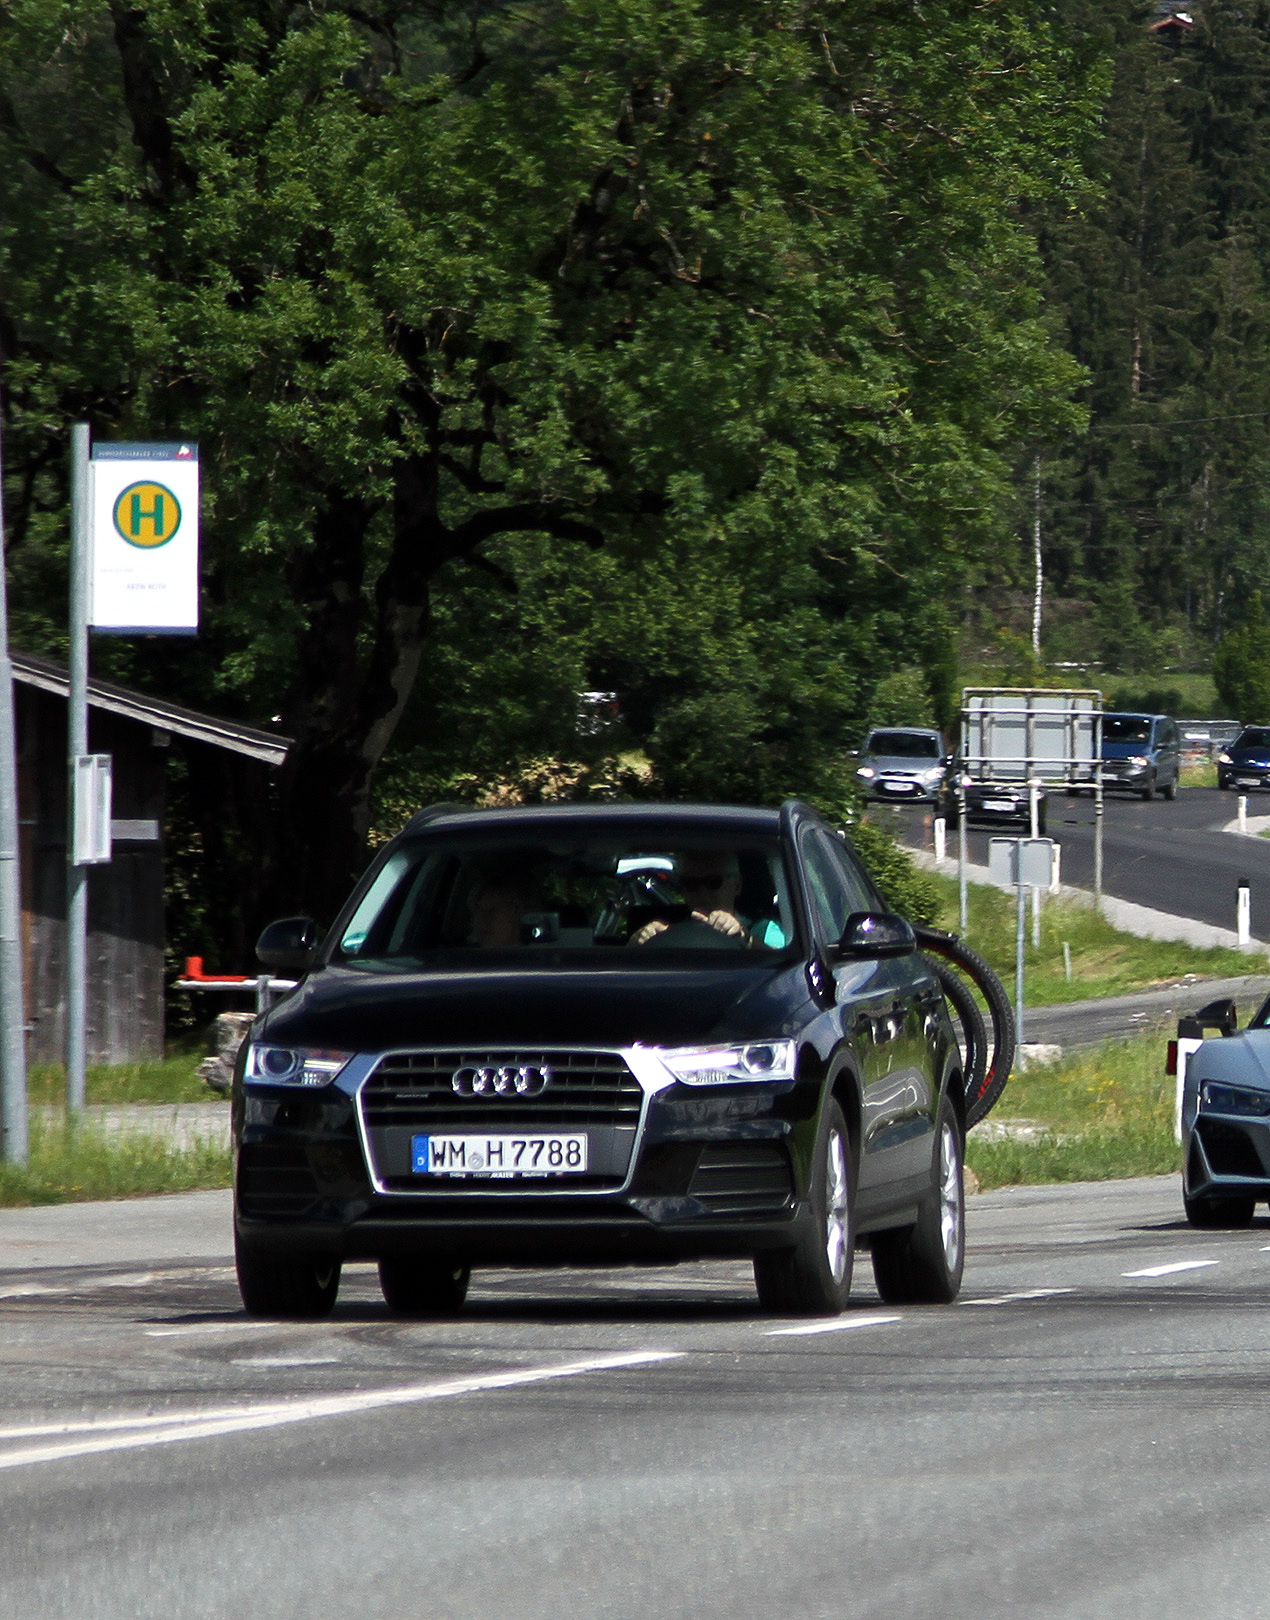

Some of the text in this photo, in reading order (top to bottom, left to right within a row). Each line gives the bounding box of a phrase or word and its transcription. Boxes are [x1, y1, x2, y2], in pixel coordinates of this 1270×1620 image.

[131, 494, 164, 536] H
[430, 1141, 466, 1167] WM
[486, 1140, 503, 1167] H
[511, 1139, 582, 1167] 7788
